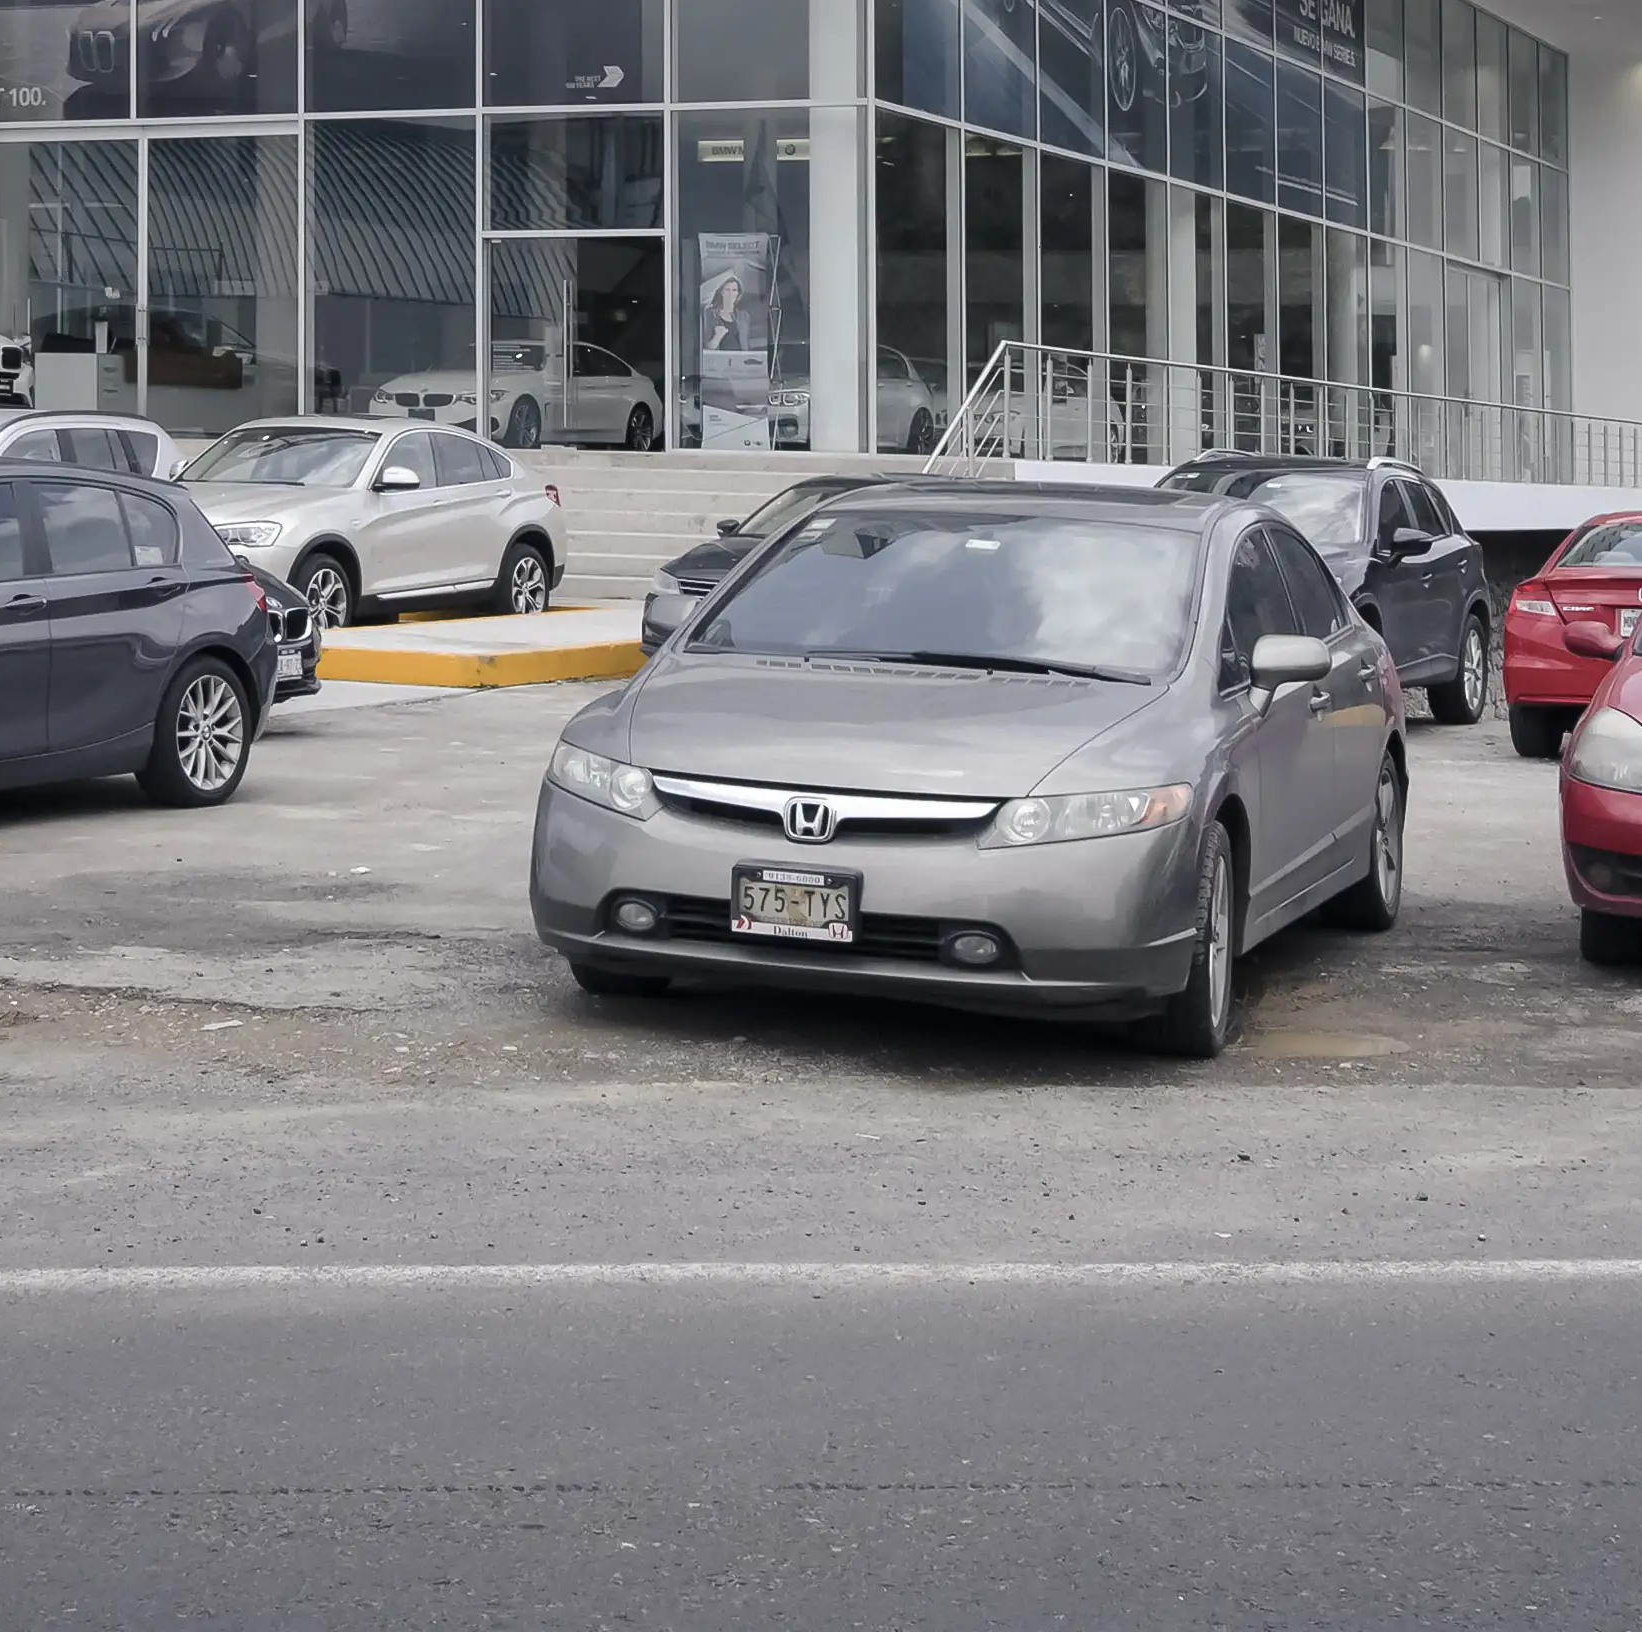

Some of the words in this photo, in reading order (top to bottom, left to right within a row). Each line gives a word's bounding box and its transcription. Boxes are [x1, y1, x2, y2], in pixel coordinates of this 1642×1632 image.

[8, 86, 47, 107] 100.
[743, 885, 847, 921] 575-TYS
[773, 925, 808, 938] Dalton
